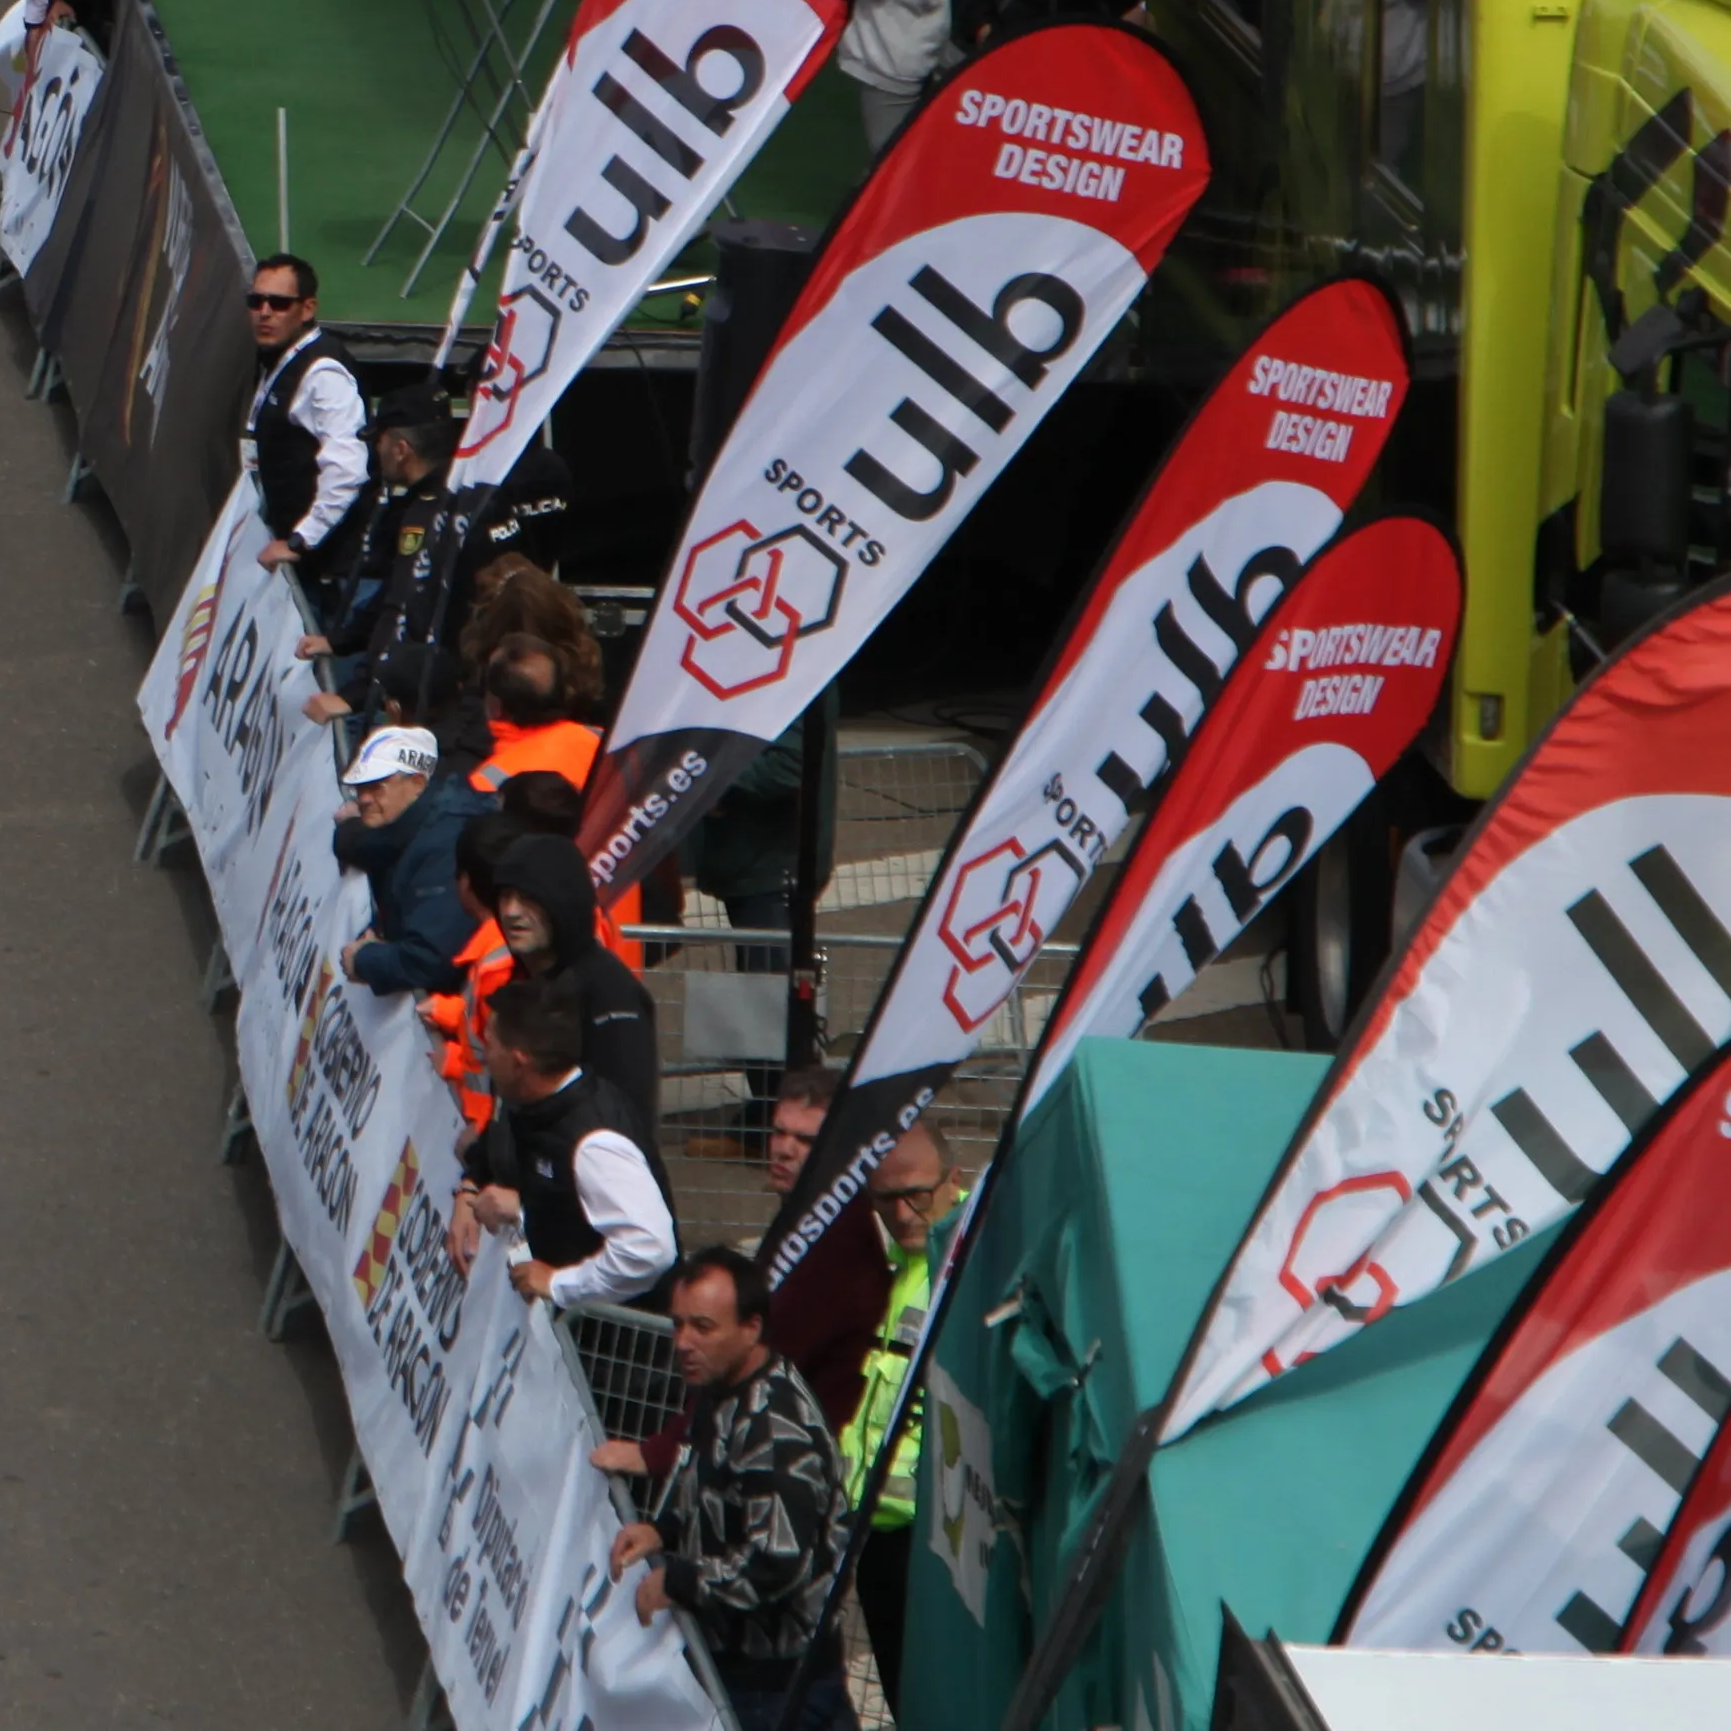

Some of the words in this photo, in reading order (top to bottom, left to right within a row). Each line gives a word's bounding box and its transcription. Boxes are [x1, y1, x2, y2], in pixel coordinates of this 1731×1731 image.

[564, 21, 768, 268] ulb
[956, 90, 1185, 172] SPORTSWEAR
[992, 140, 1127, 204] DESIGN
[843, 261, 1087, 525] ulb
[1248, 352, 1394, 420] SPORTSWEAR
[1265, 409, 1354, 464] DESIGN
[762, 456, 888, 570] SPORTS
[1265, 623, 1442, 673] SPORTSWEAR
[1295, 674, 1384, 722] DESIGN
[591, 746, 709, 892] ports.es
